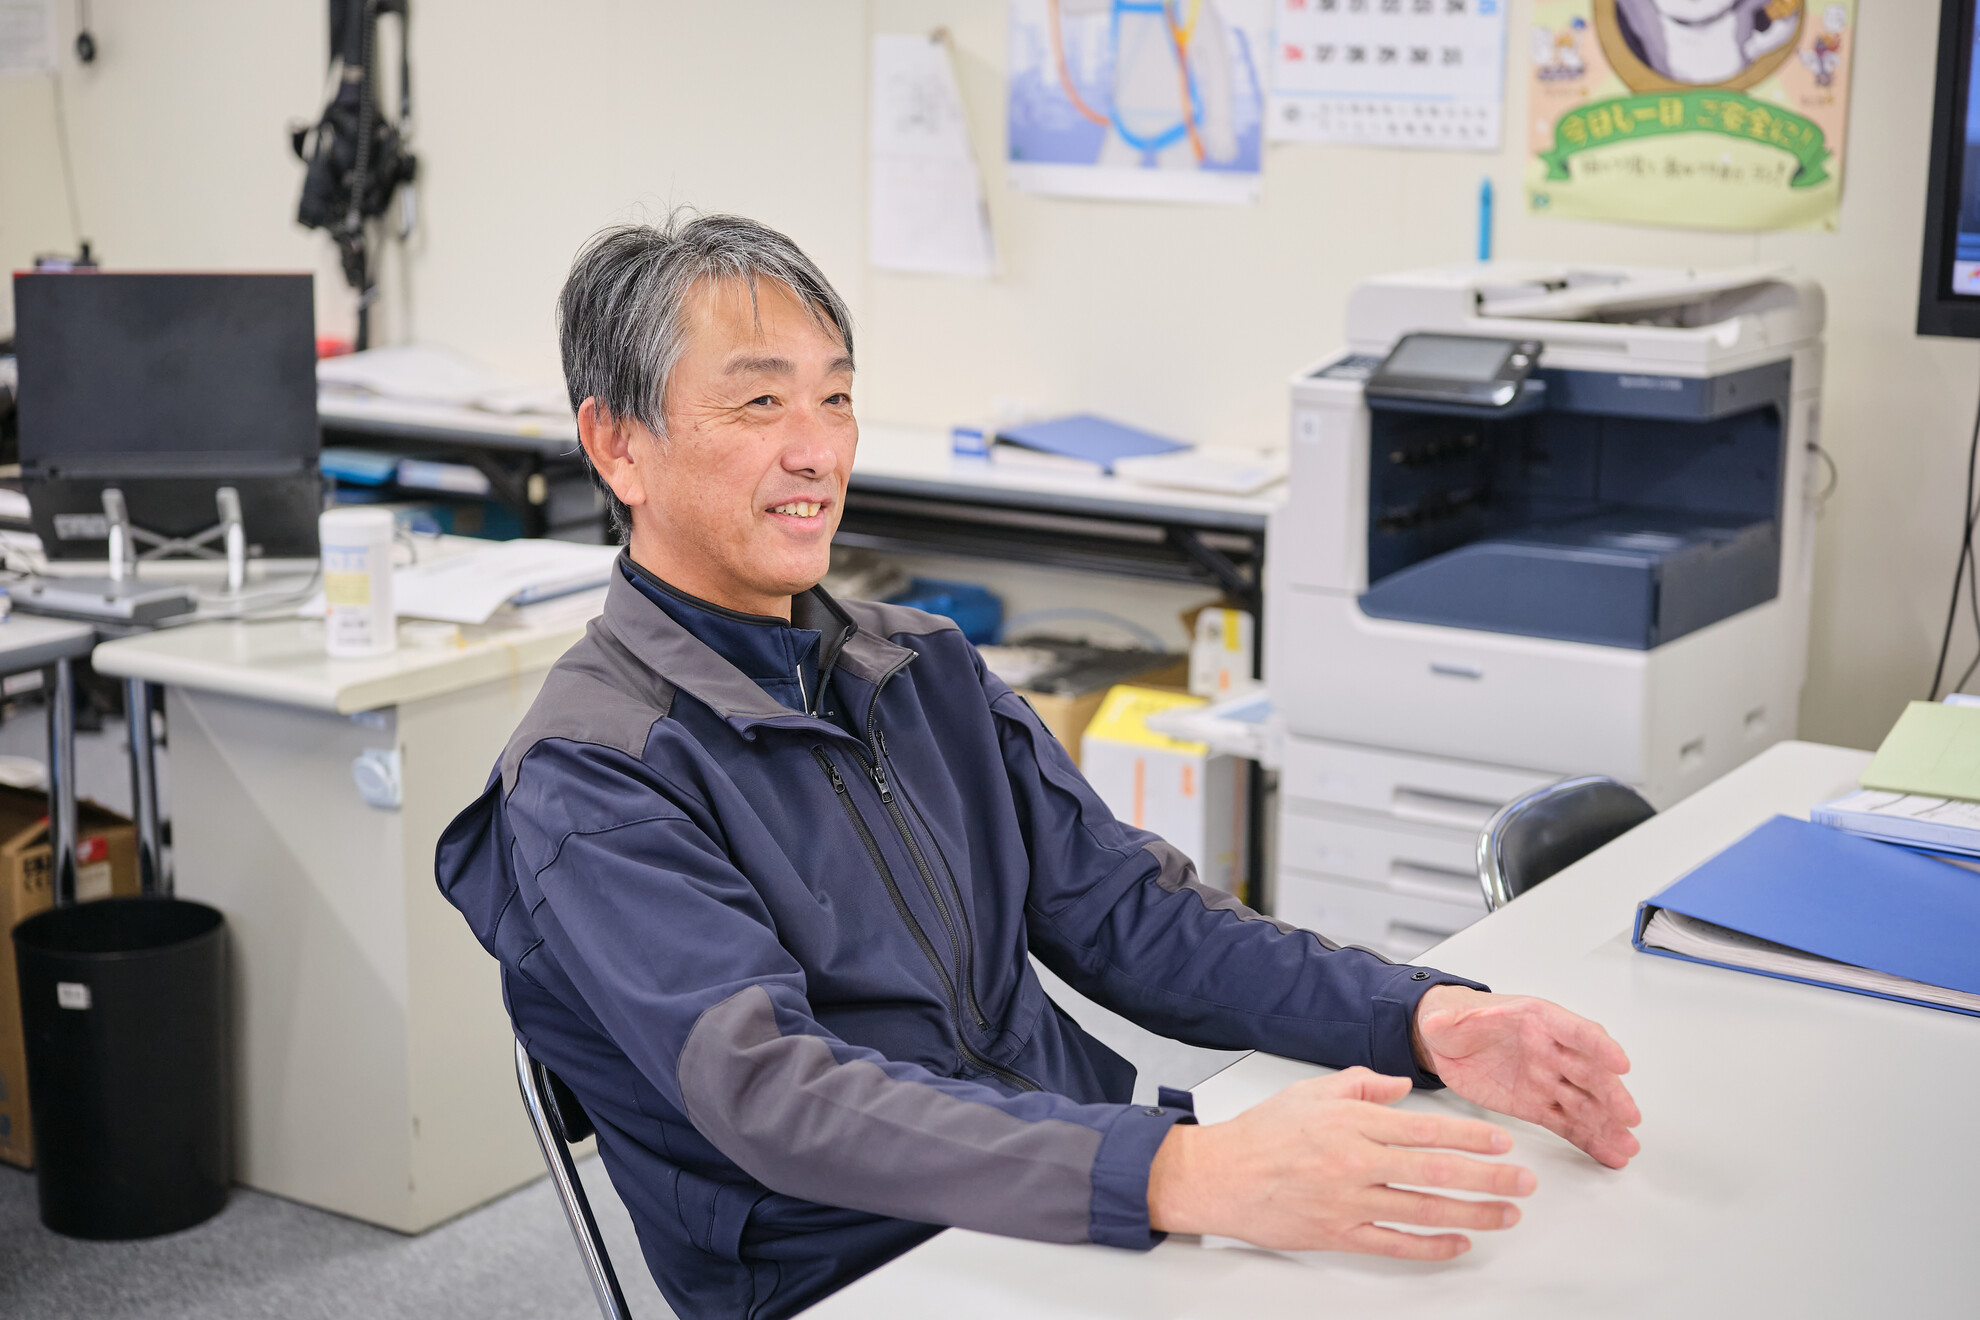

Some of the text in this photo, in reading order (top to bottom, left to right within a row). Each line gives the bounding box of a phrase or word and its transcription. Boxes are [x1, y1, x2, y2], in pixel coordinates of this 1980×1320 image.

[1316, 45, 1334, 63] 27
[1348, 46, 1365, 63] 28
[1379, 46, 1396, 64] 29
[1410, 47, 1429, 64] 30
[1441, 47, 1461, 65] 31
